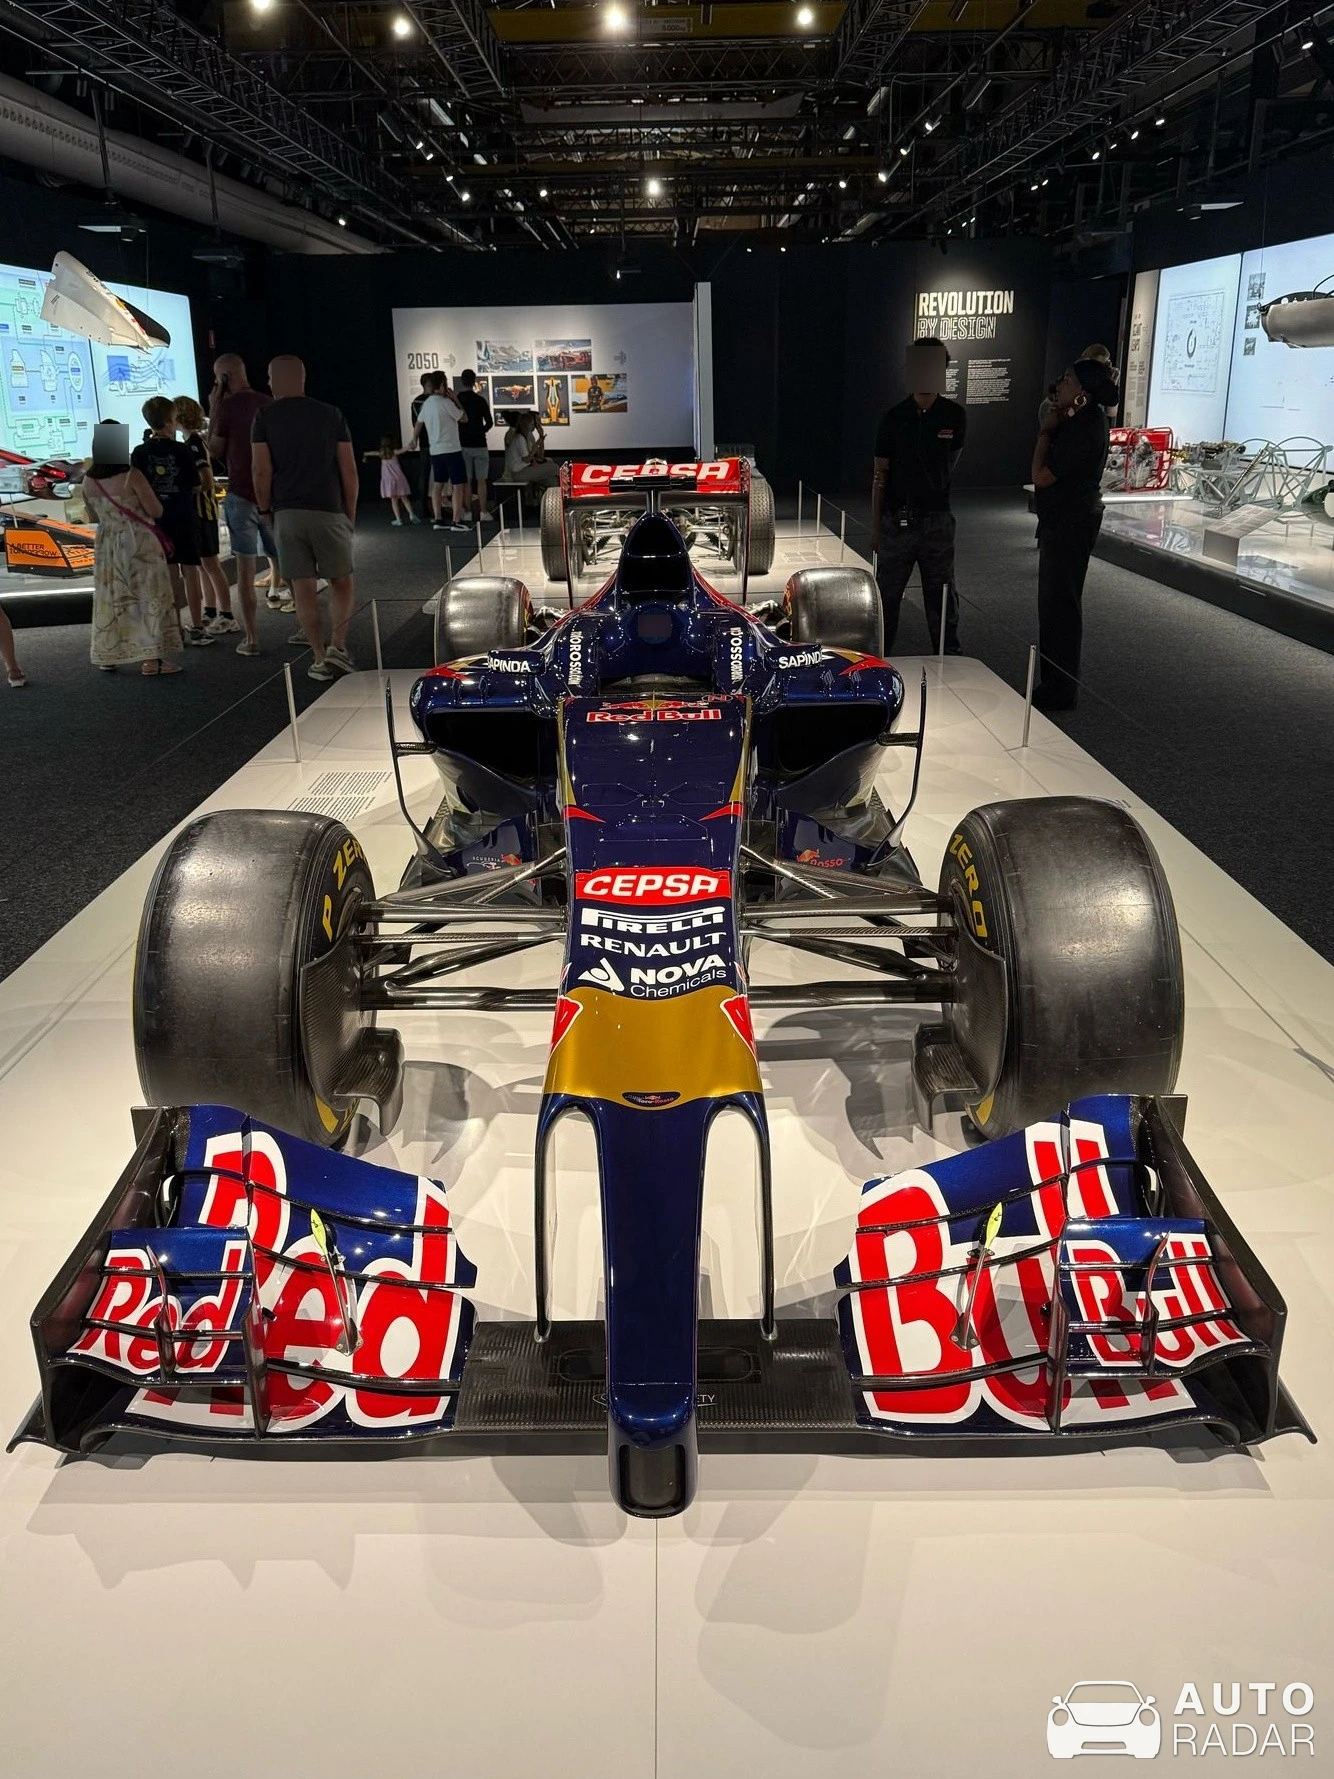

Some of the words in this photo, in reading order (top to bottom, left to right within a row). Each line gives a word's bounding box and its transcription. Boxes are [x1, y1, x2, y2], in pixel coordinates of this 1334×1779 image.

[918, 291, 1014, 316] REVOLUTION
[917, 317, 938, 339] BY
[939, 316, 997, 340] DESIGN
[407, 352, 439, 370] 2050
[779, 651, 822, 669] SAPIND
[586, 711, 654, 723] Red
[656, 709, 722, 721] Bull
[333, 838, 369, 891] ZER
[583, 874, 719, 897] CEPSA
[949, 833, 988, 938] ZERO
[581, 906, 726, 934] PIRELLI
[580, 932, 727, 958] RENAULT
[630, 954, 727, 985] NOVA
[630, 966, 727, 998] Chemicals
[125, 1130, 458, 1432] Red
[850, 1119, 1197, 1430] Bull
[67, 1240, 249, 1374] Red
[1065, 1233, 1251, 1367] Bull
